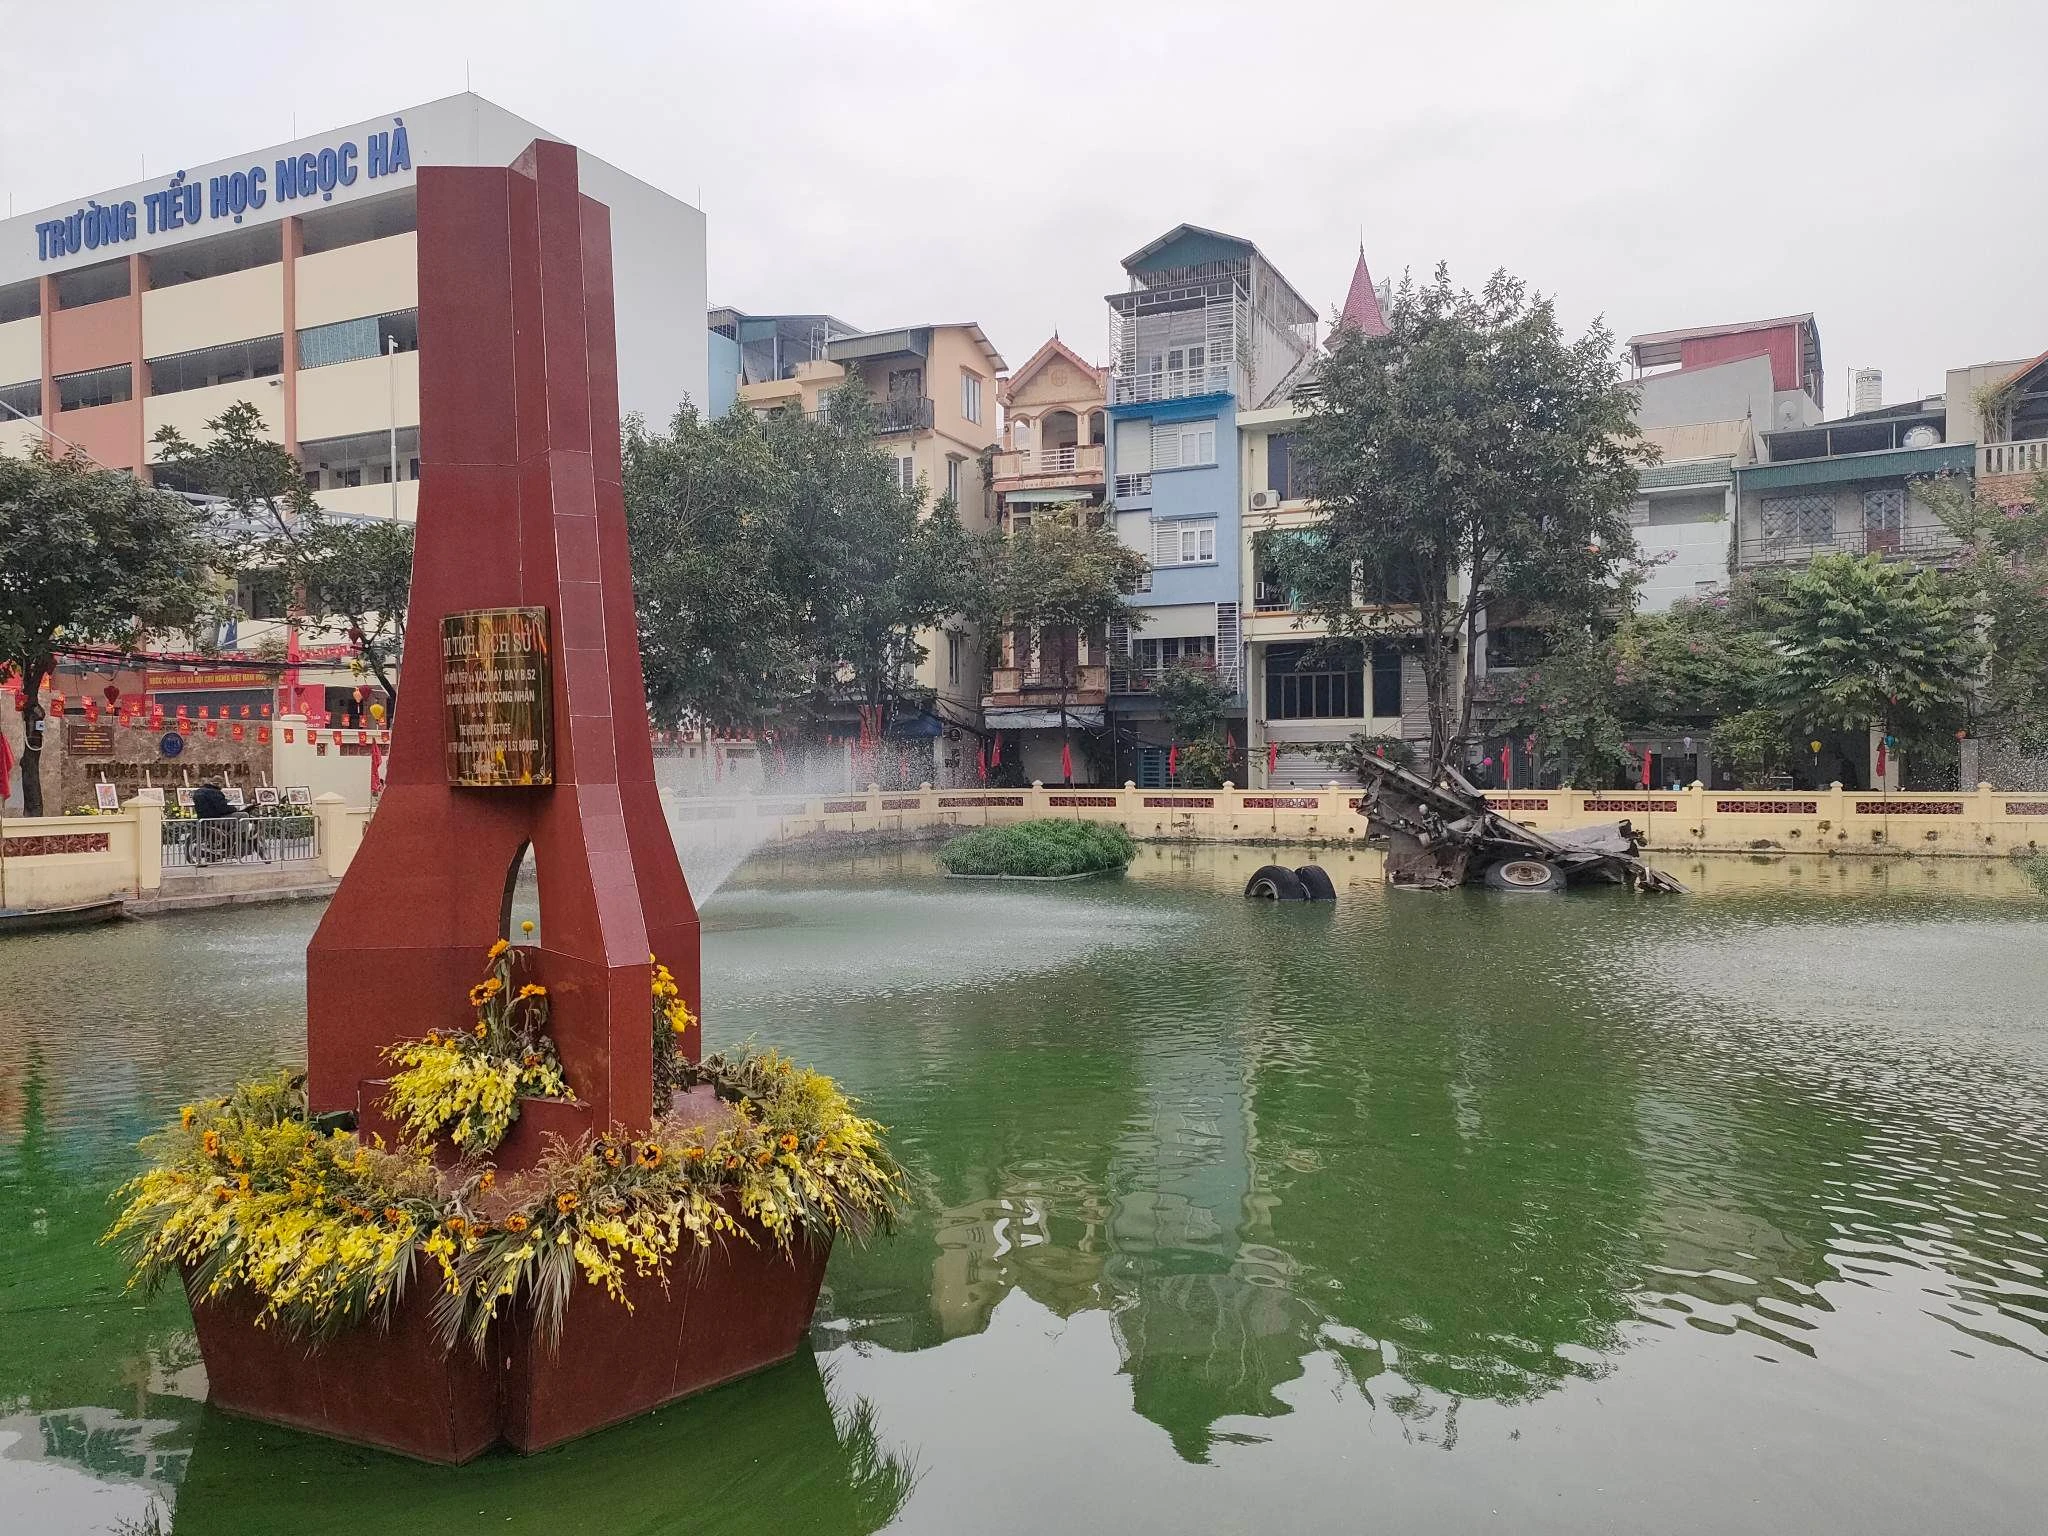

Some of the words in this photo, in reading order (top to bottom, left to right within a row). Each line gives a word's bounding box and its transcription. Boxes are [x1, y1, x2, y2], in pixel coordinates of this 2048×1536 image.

[35, 200, 136, 261] TRƯỜNG
[143, 169, 202, 234] TIỂU
[209, 166, 266, 224] HỌC
[275, 141, 358, 201] NGỌC
[367, 117, 411, 178] HÀ
[504, 667, 520, 681] BAY
[493, 688, 512, 703] CÔNG
[514, 687, 535, 705] NHẬN
